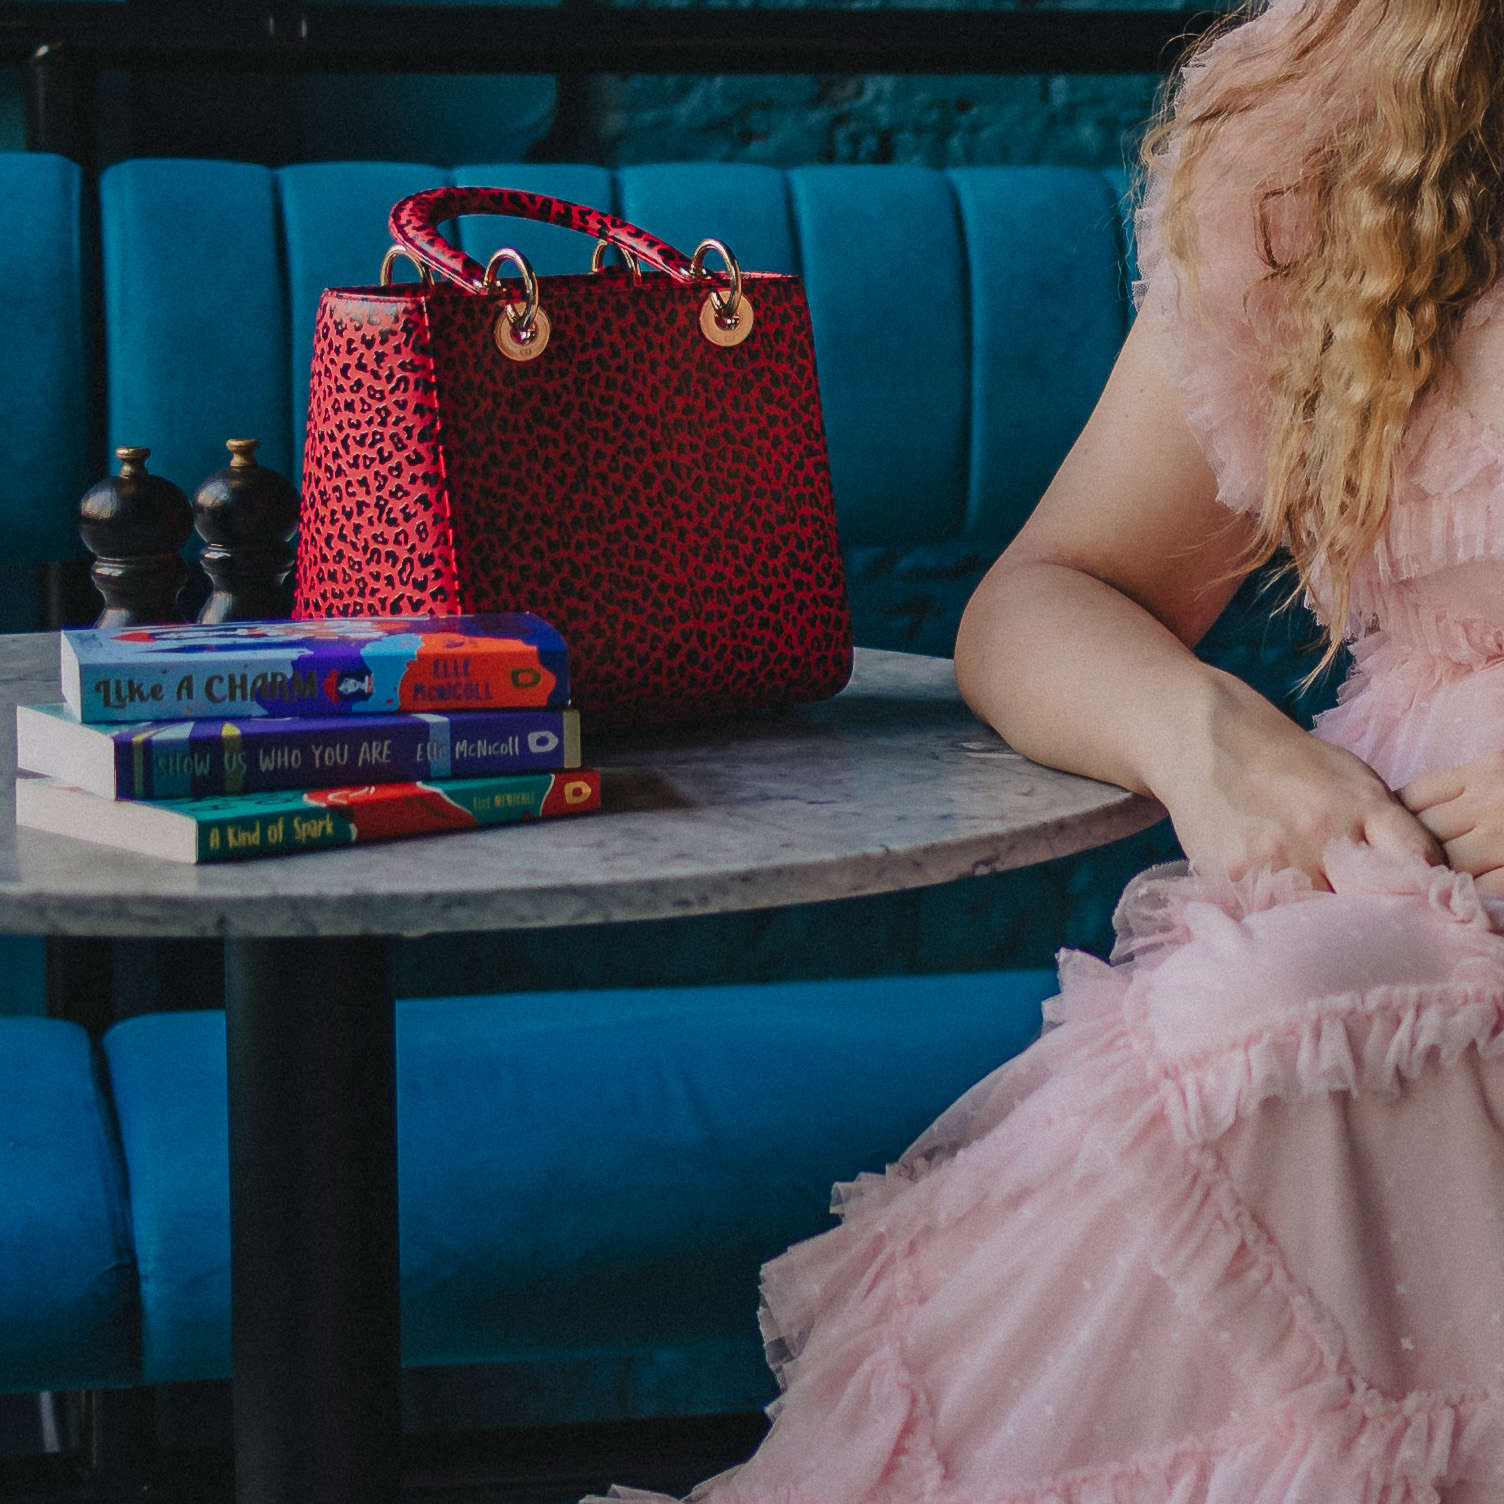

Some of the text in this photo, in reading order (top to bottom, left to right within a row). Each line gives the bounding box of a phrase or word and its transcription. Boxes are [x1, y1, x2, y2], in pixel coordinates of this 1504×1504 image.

[432, 658, 471, 678] ELLE
[177, 675, 194, 700] A
[205, 672, 317, 704] CHARM
[157, 740, 392, 777] SHOW US WHO YOU ARE
[455, 735, 519, 760] McNicoll
[210, 813, 333, 850] A Kind of Spark
